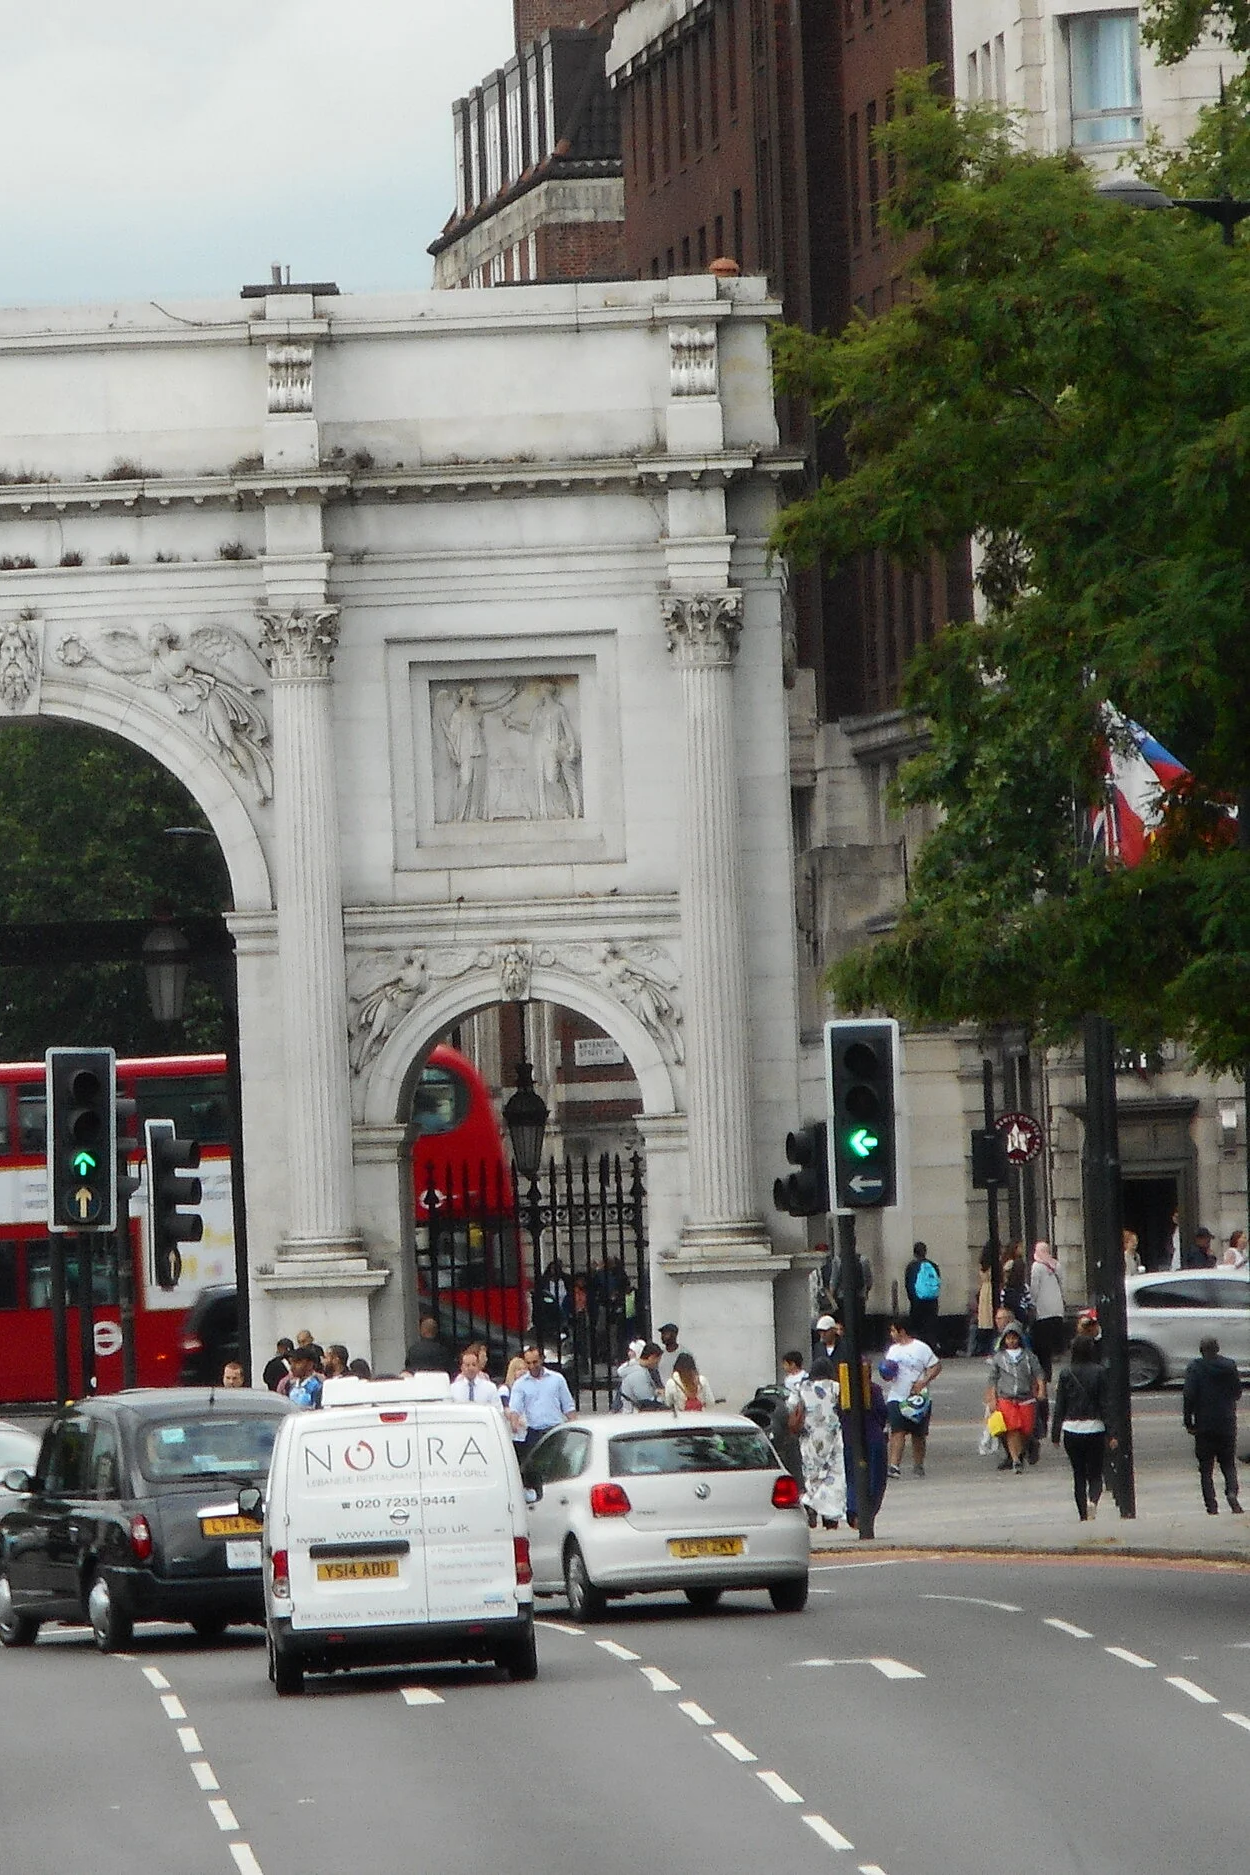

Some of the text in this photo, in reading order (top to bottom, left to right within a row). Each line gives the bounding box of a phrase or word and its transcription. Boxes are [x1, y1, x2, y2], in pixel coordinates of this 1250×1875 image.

[305, 1436, 488, 1475] NOURA
[356, 1495, 456, 1509] 020 7235 9444
[325, 1561, 391, 1579] YS14 ADU
